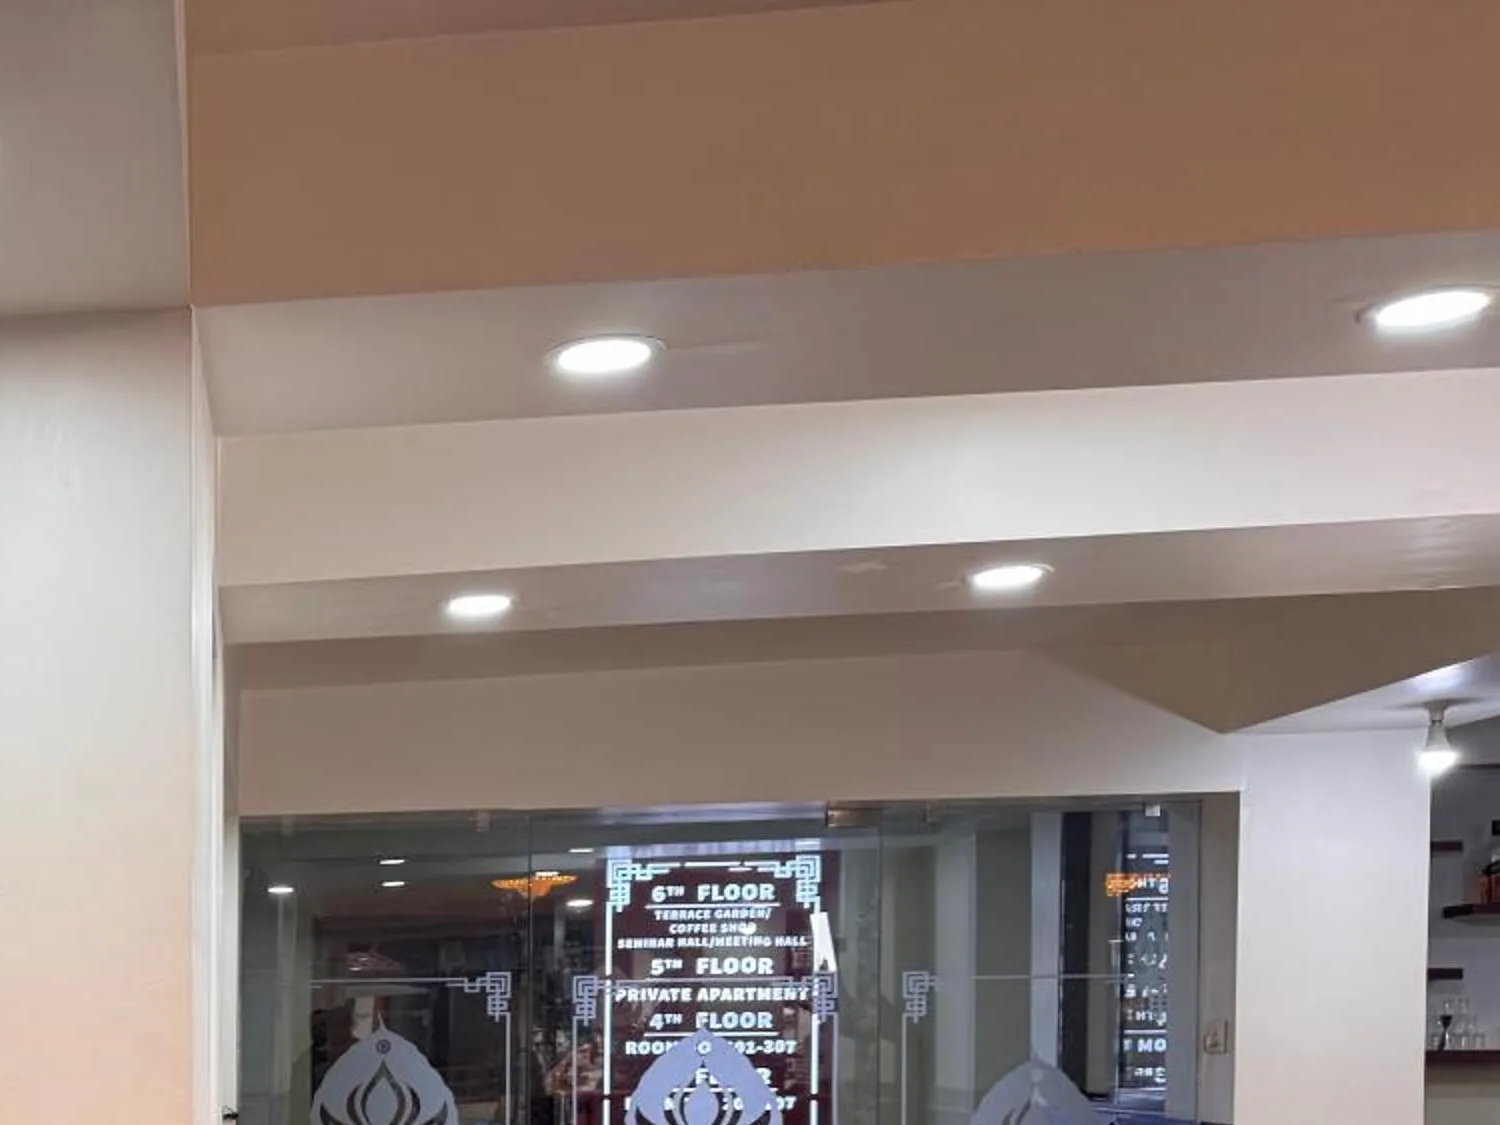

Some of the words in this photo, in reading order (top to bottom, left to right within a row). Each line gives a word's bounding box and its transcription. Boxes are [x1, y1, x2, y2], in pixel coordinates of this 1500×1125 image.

[651, 884, 685, 903] 6TH
[697, 882, 776, 901] FLOOR
[654, 909, 711, 921] TERRACE
[669, 923, 717, 935] COFFEE
[775, 935, 811, 947] HALL
[650, 958, 683, 975] 5TH
[695, 956, 774, 975] FLOOR
[615, 987, 692, 1002] PRIVATE
[696, 987, 810, 1002] APARTMENT
[649, 1013, 683, 1030] 4TH
[695, 1010, 773, 1029] FLOOR
